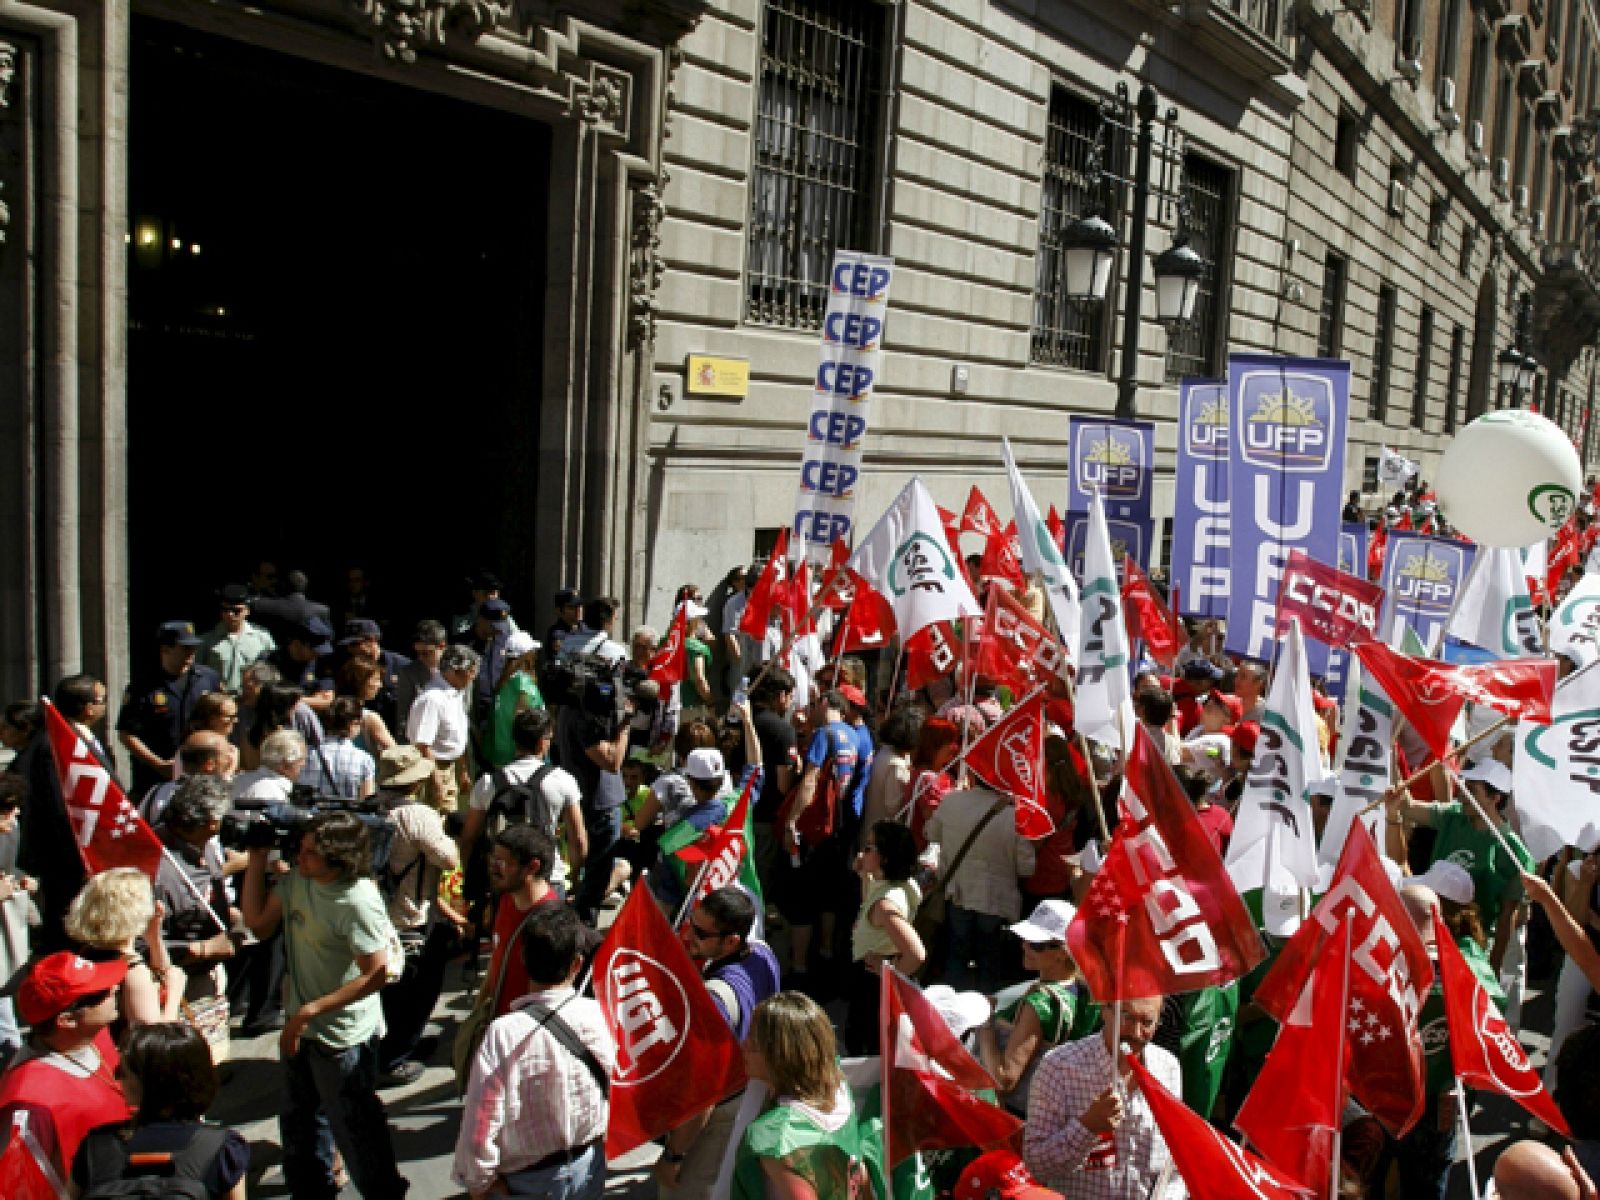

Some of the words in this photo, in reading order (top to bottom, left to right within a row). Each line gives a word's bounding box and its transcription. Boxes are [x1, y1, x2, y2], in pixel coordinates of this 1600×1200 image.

[833, 262, 890, 298] CEP
[825, 312, 881, 347] CEP
[817, 362, 873, 396] CEP
[809, 410, 865, 446] CEP
[1192, 424, 1229, 445] UF
[1249, 424, 1324, 453] UFP
[801, 461, 858, 496] CEP
[1084, 461, 1138, 486] UFP
[795, 510, 850, 544] CEP
[1397, 575, 1452, 600] UFP
[611, 961, 679, 1068] UGT
